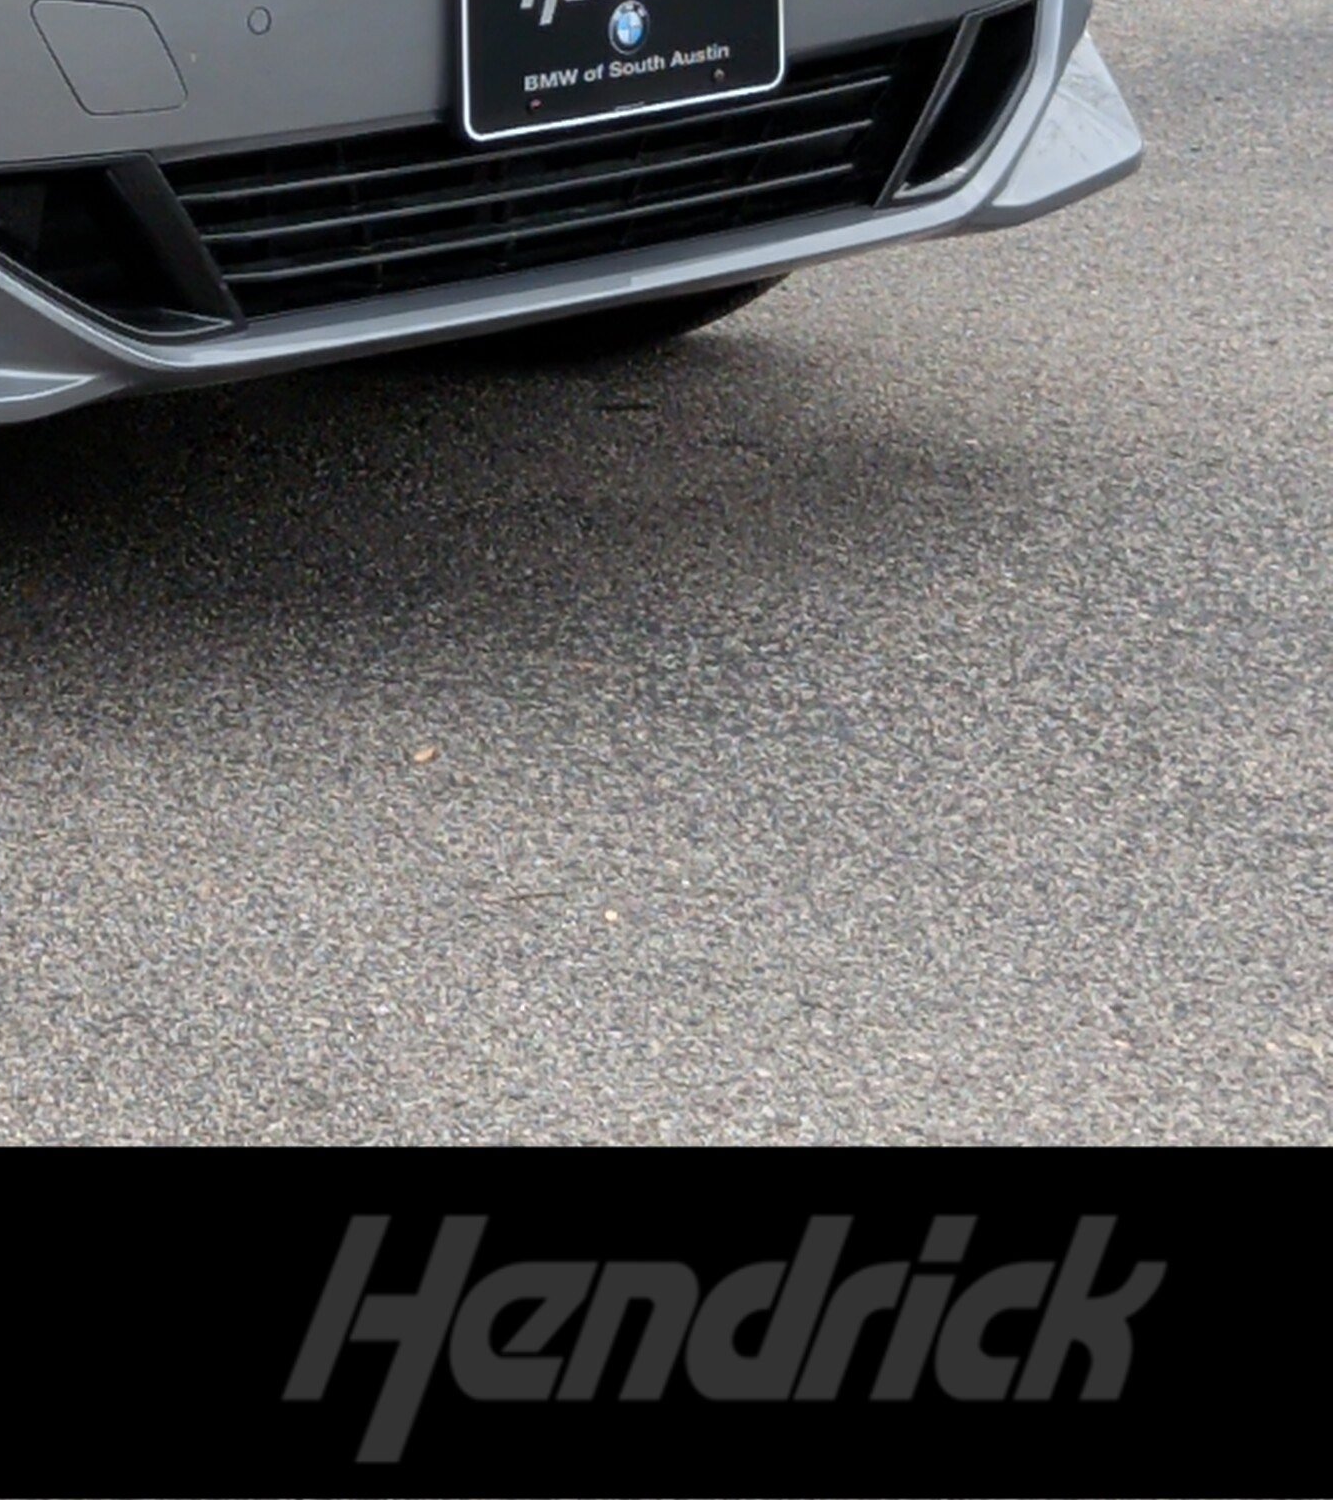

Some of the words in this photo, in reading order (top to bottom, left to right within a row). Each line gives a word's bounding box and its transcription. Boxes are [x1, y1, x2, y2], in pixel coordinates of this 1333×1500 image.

[523, 68, 578, 92] BMW
[583, 64, 605, 83] of
[608, 54, 665, 79] South
[670, 43, 731, 68] Austin
